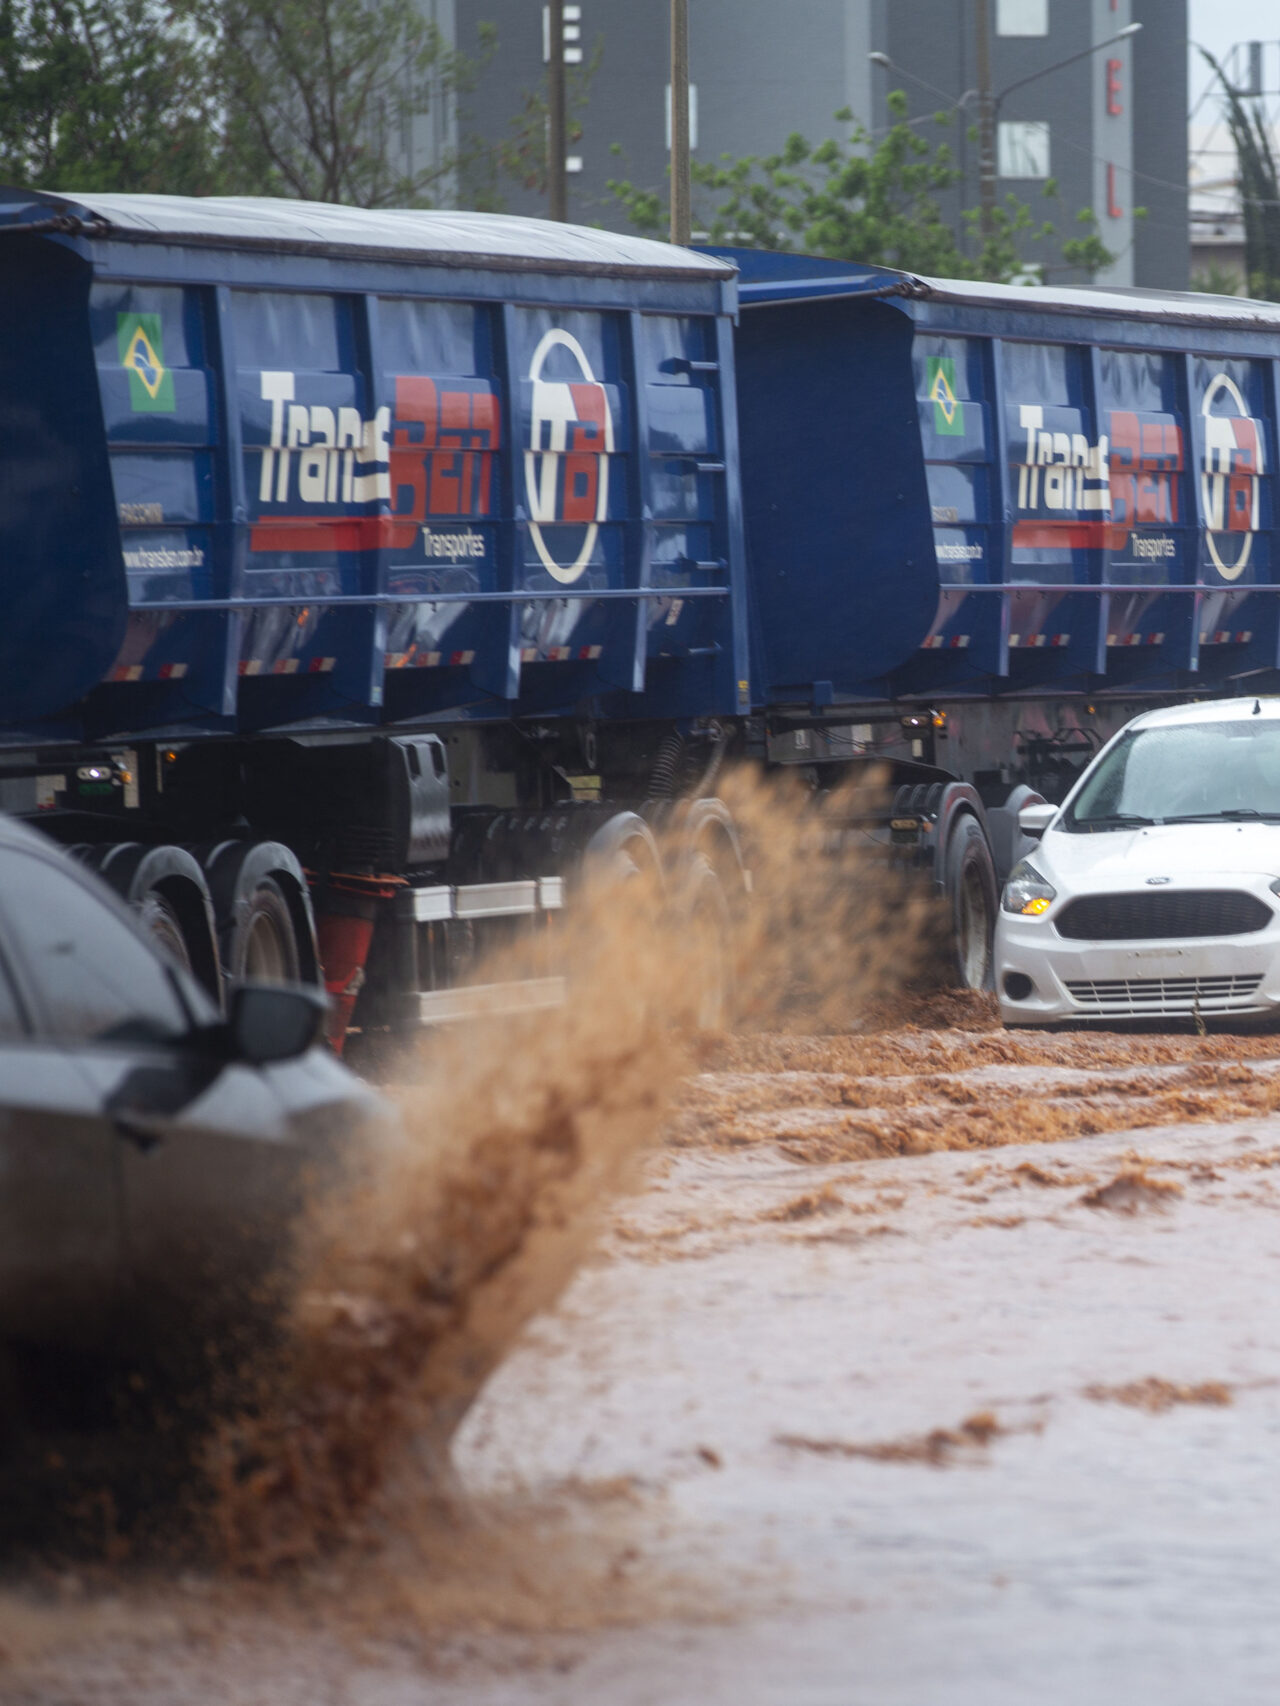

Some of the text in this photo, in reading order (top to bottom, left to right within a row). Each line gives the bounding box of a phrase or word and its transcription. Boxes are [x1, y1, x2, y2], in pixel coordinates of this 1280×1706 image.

[1105, 0, 1125, 219] EL
[422, 527, 485, 563] Transportes
[1131, 532, 1175, 561] Transportes
